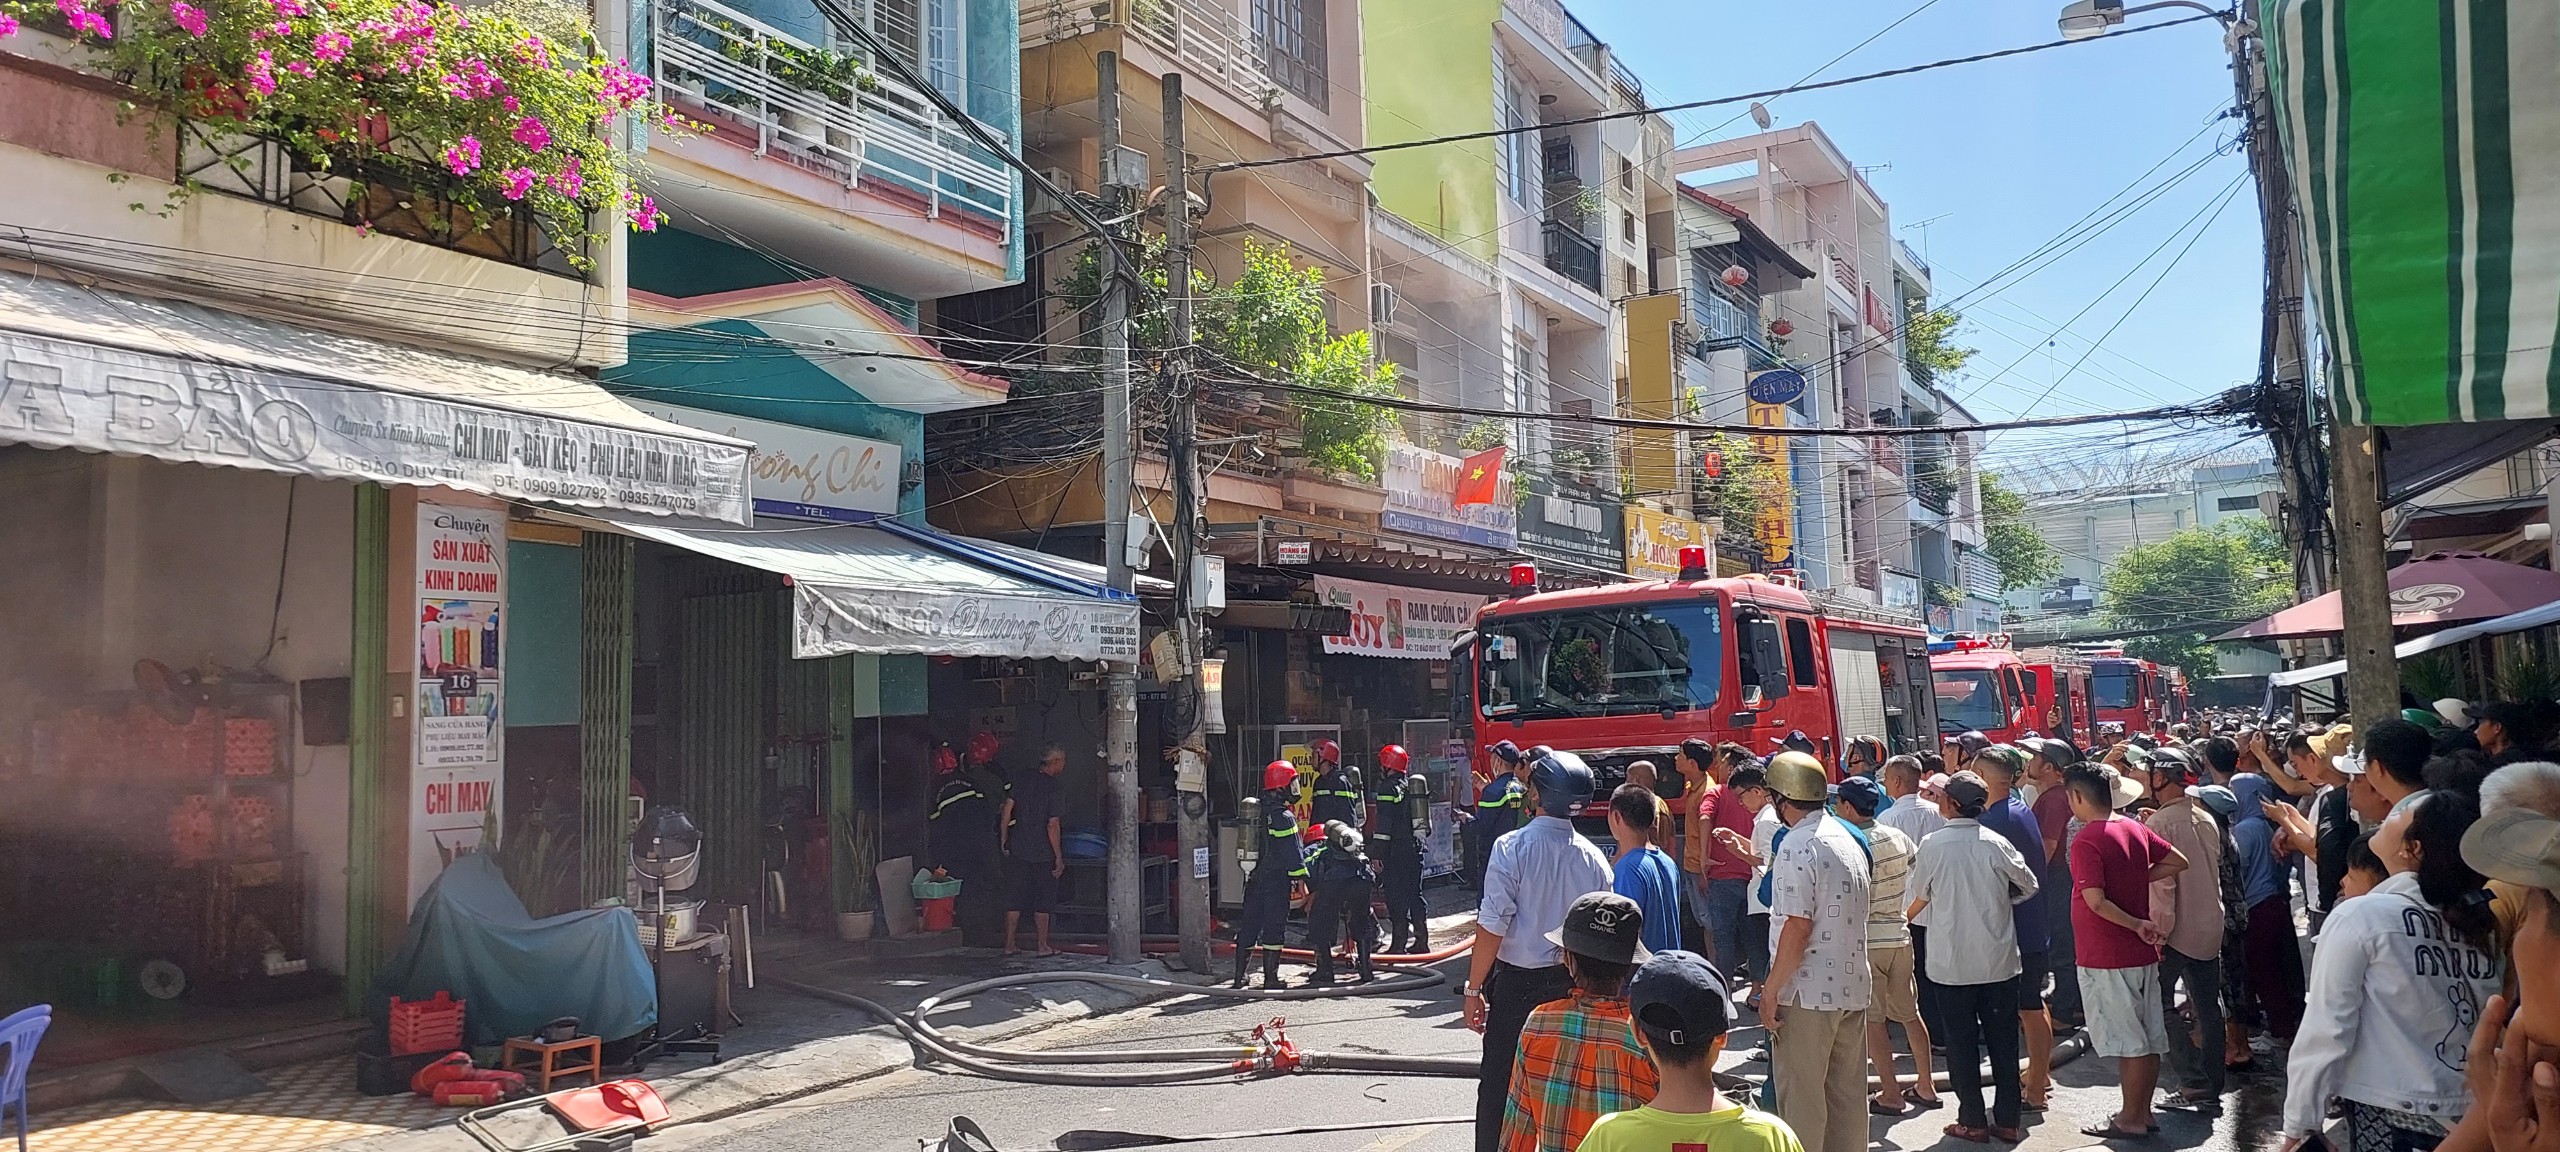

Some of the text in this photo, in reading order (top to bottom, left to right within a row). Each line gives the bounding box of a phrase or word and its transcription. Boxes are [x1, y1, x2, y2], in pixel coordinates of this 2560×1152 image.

[106, 372, 317, 463] BẢO
[376, 421, 388, 440] Sx
[389, 422, 413, 443] Kinh
[454, 415, 477, 459] CHỈ
[482, 426, 511, 464] MAY
[589, 442, 614, 486] PHỤ
[617, 441, 643, 487] LIỆU
[645, 450, 670, 484] MAY
[673, 449, 697, 494] MẶC
[360, 456, 398, 476] ĐÀO
[403, 463, 437, 479] DUY
[826, 446, 886, 494] Chi
[493, 474, 519, 490] ĐT:
[523, 477, 607, 500] 0909.027792
[620, 489, 697, 511] 0935.747079
[433, 514, 490, 536] Chuyên
[433, 533, 491, 564] SẢN XUẤT
[425, 569, 497, 593] KINH DOANH
[1407, 602, 1429, 622] RAM
[1431, 599, 1456, 624] CUỐN
[451, 674, 471, 689] 16
[1592, 765, 1625, 779] AN
[426, 771, 490, 815] CHỈ MAY
[1589, 922, 1617, 935] CHANEL
